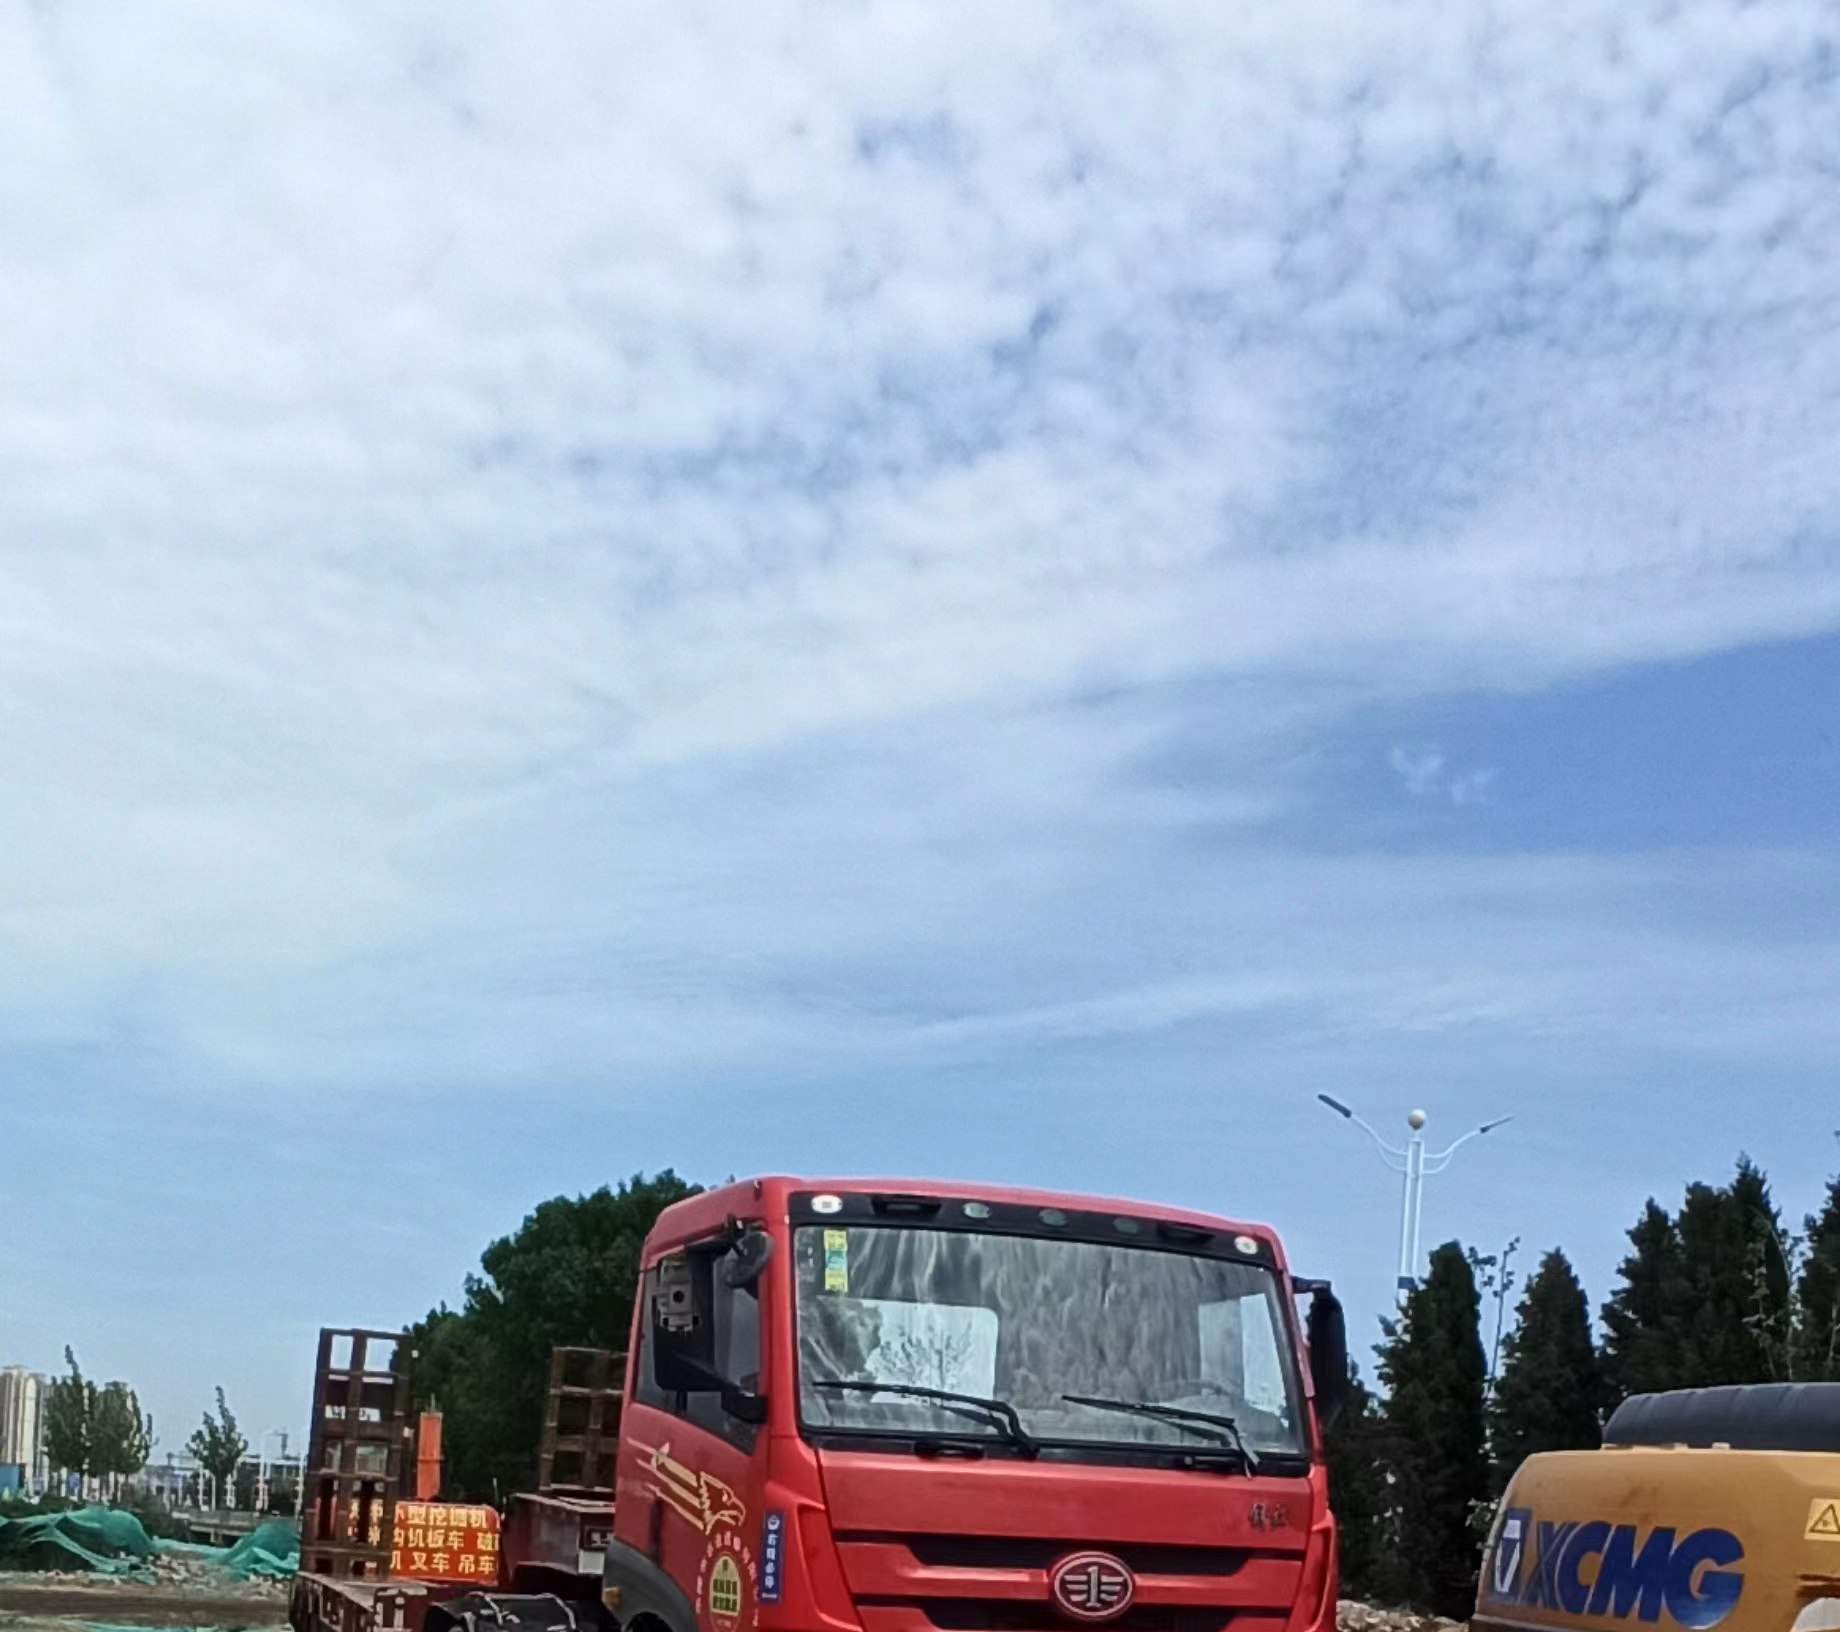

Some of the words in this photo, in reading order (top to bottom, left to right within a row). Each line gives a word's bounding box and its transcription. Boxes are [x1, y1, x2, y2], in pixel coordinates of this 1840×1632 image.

[410, 1551, 450, 1573] 叉车
[458, 1554, 494, 1575] 吊车
[1519, 1521, 1745, 1629] XCMG
